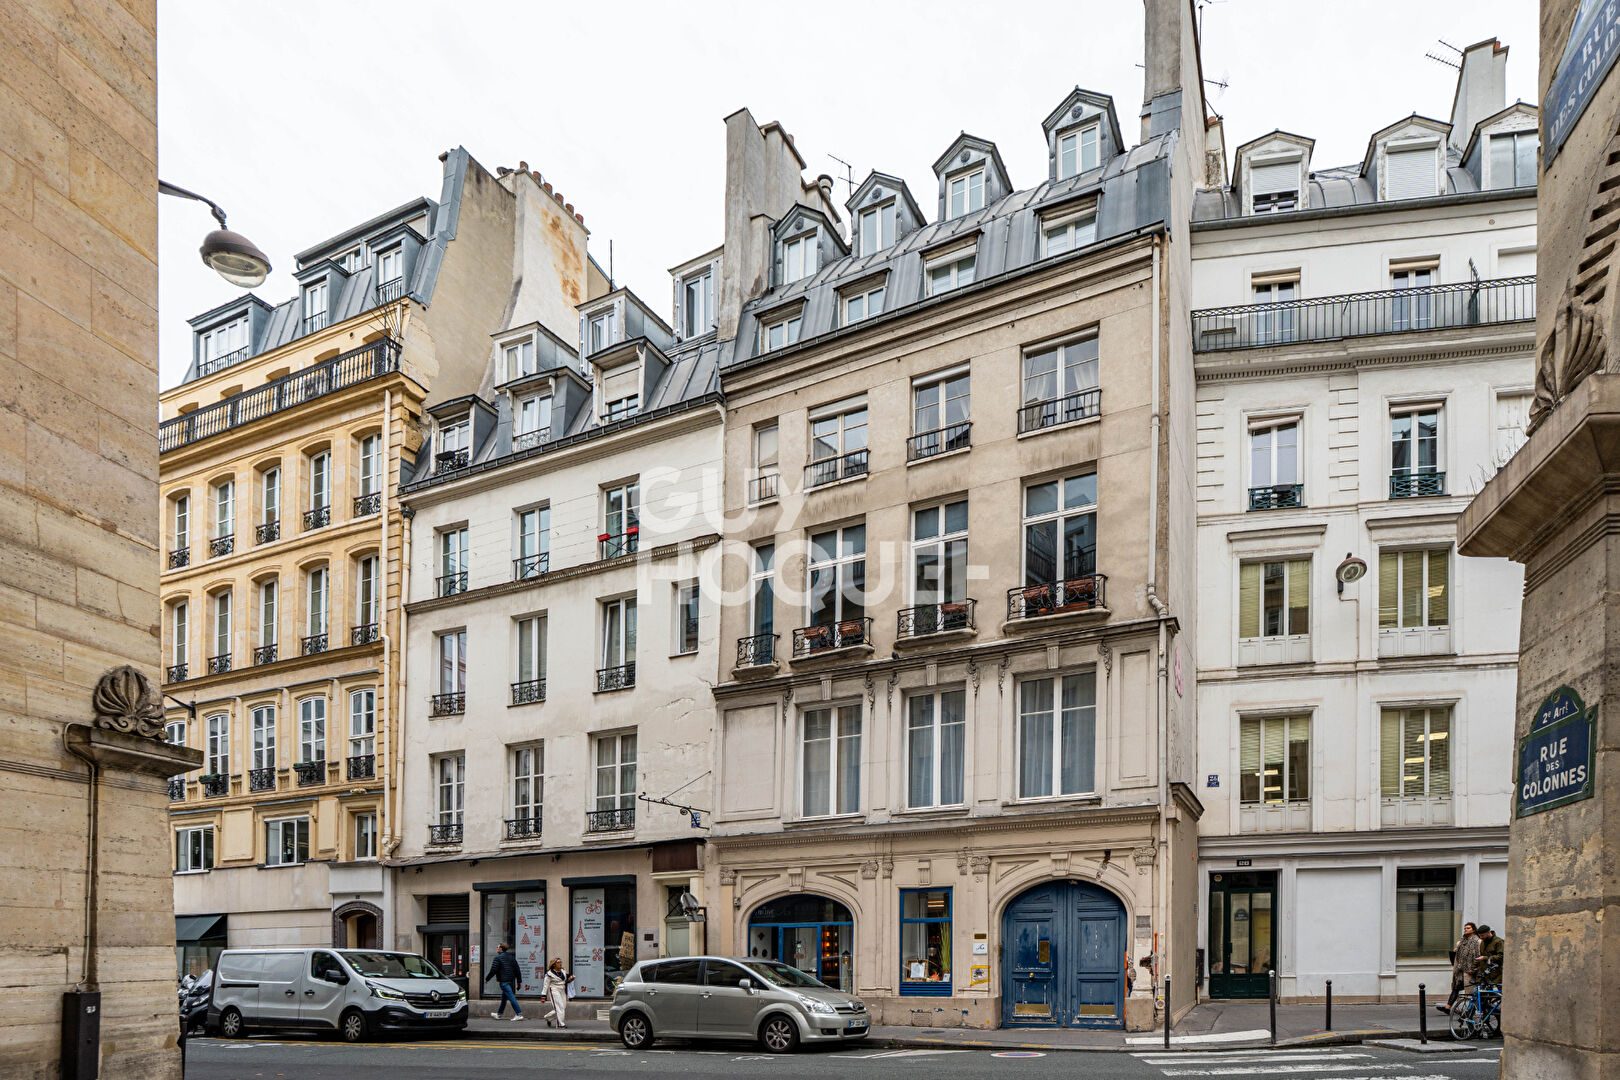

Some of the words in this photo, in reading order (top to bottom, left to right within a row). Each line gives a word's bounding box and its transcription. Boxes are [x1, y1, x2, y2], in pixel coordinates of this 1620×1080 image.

[1583, 1, 1617, 64] RUE
[1550, 91, 1577, 142] DES
[1540, 737, 1568, 762] RUE
[1546, 760, 1560, 772] DES
[1522, 765, 1586, 800] COLONNES
